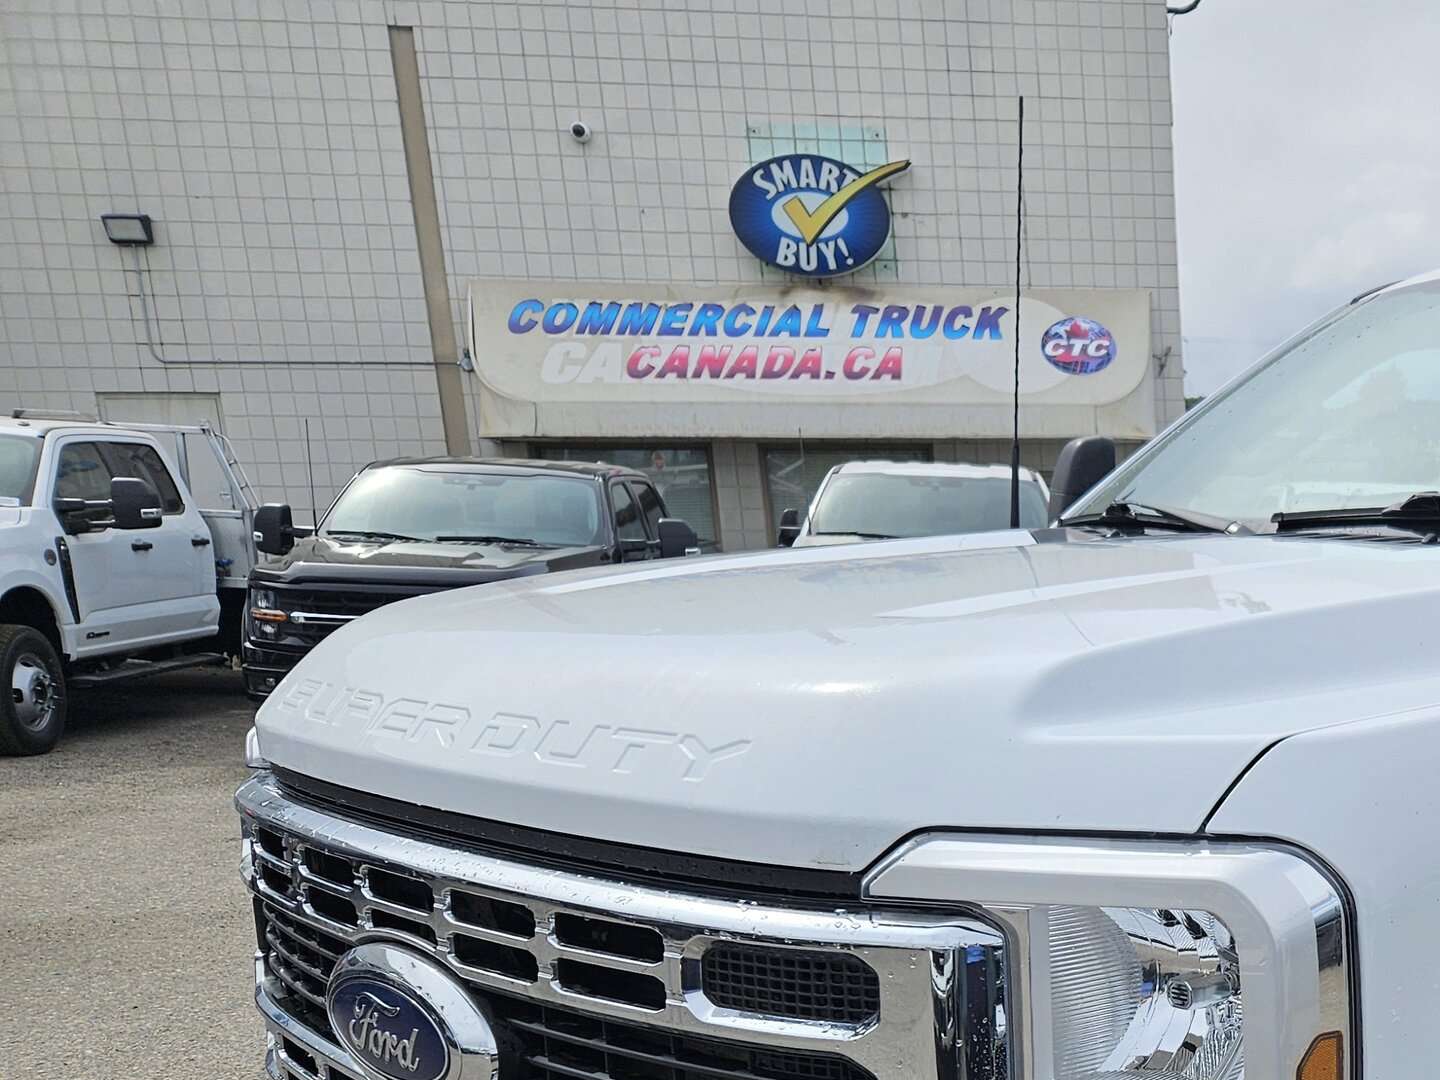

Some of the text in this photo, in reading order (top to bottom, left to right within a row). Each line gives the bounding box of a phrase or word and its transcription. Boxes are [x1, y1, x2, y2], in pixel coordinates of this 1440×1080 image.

[752, 158, 861, 201] SMART
[775, 236, 855, 272] BUY!
[507, 298, 1011, 340] COMMERCIAL TRUCK
[625, 344, 904, 382] CANADA.CA
[1044, 338, 1110, 357] CTC
[277, 677, 753, 783] SUPER DUTY
[349, 991, 421, 1073] Ford
